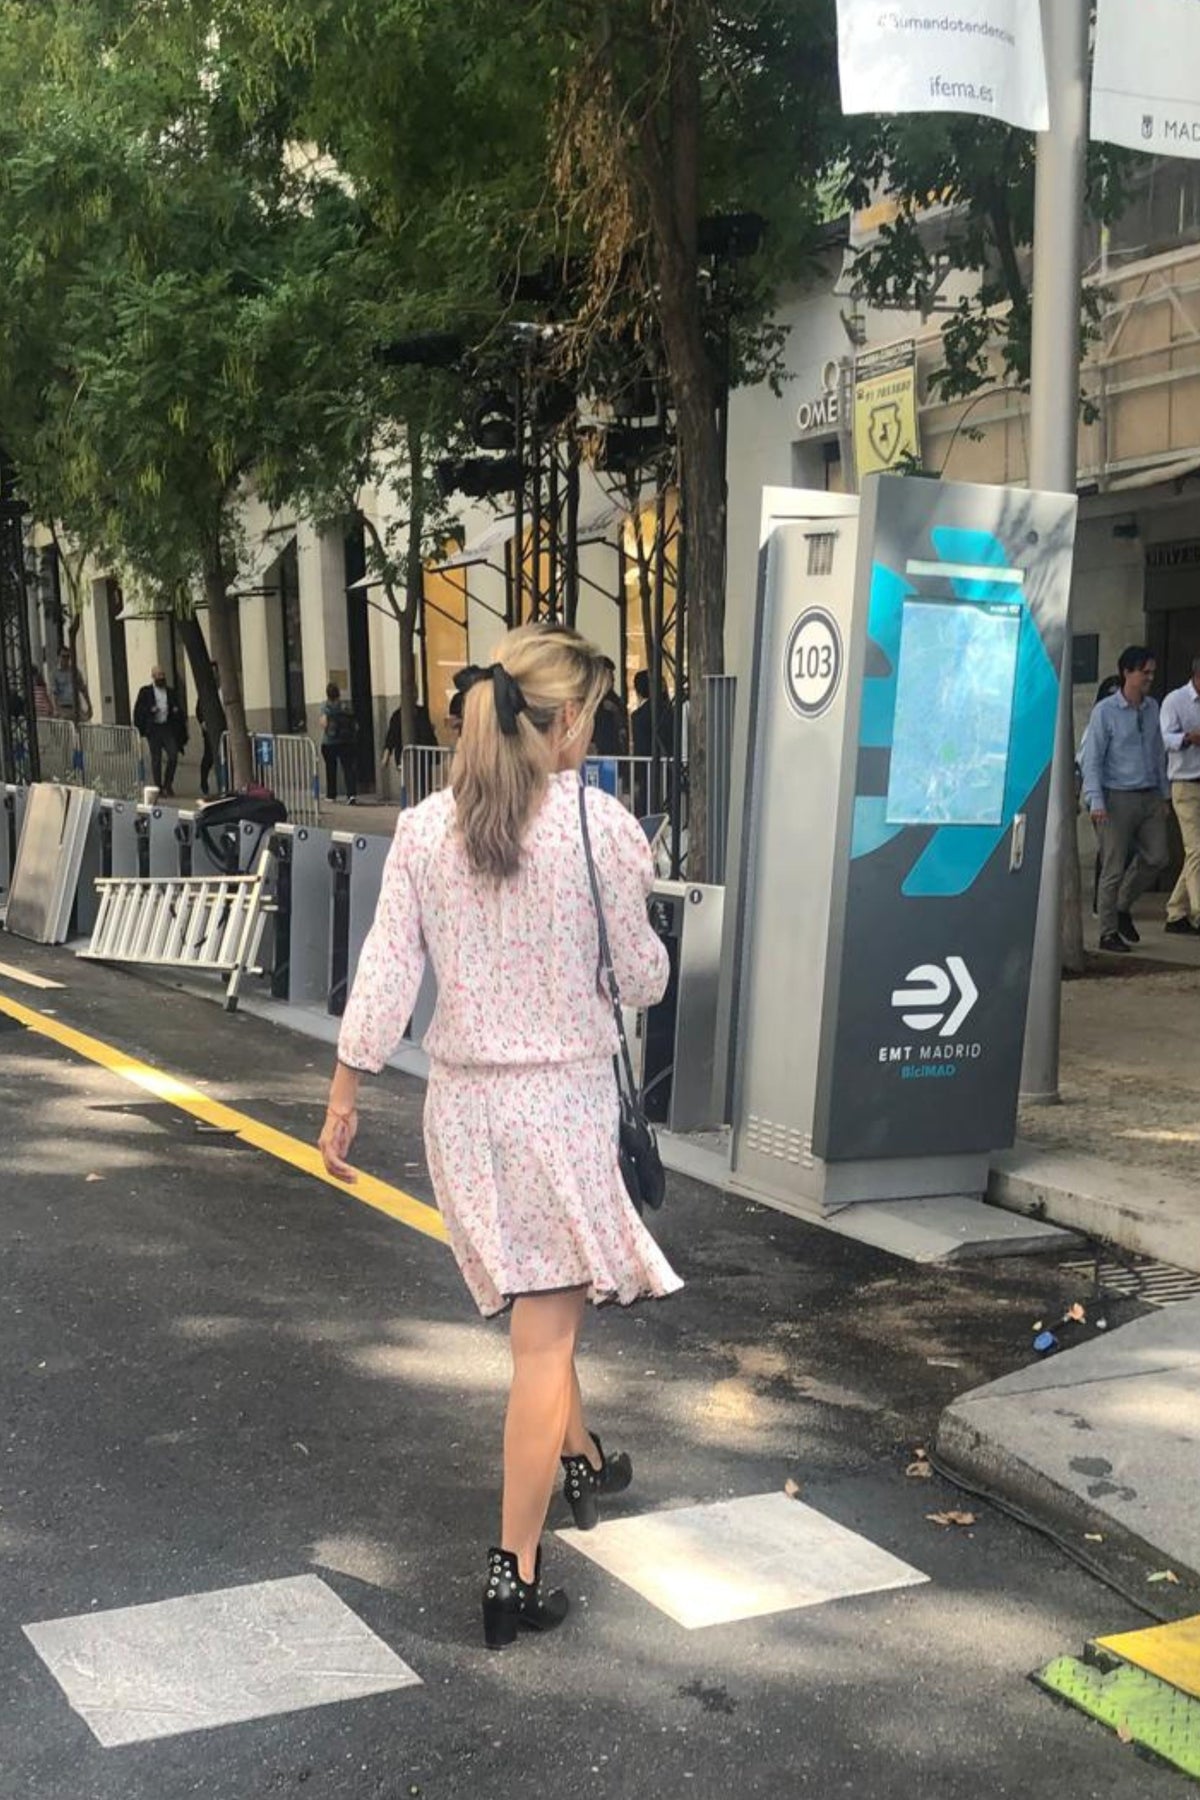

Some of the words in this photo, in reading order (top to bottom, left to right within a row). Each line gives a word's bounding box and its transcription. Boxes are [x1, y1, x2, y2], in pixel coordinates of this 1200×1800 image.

[929, 74, 994, 103] ifema.es
[797, 395, 841, 429] OME
[794, 644, 832, 679] 103
[878, 1046, 912, 1062] EMT
[919, 1043, 982, 1059] MADRID
[901, 1064, 957, 1079] BiciMAD
